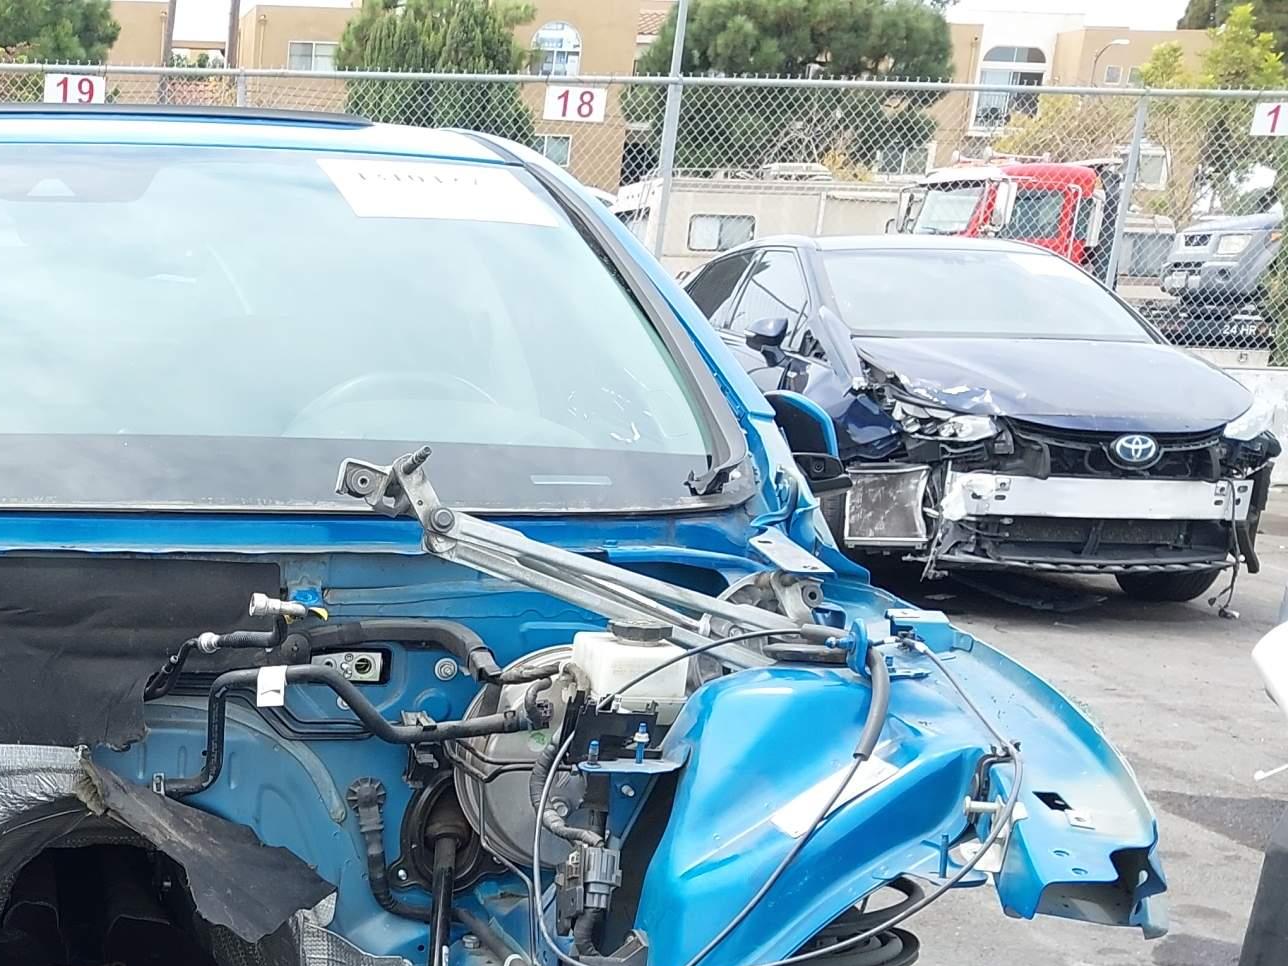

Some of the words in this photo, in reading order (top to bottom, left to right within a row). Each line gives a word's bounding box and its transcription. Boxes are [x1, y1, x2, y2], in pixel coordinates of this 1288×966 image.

[56, 76, 95, 103] 19
[557, 89, 595, 118] 18
[1222, 324, 1238, 335] 24
[1240, 324, 1257, 336] HR
